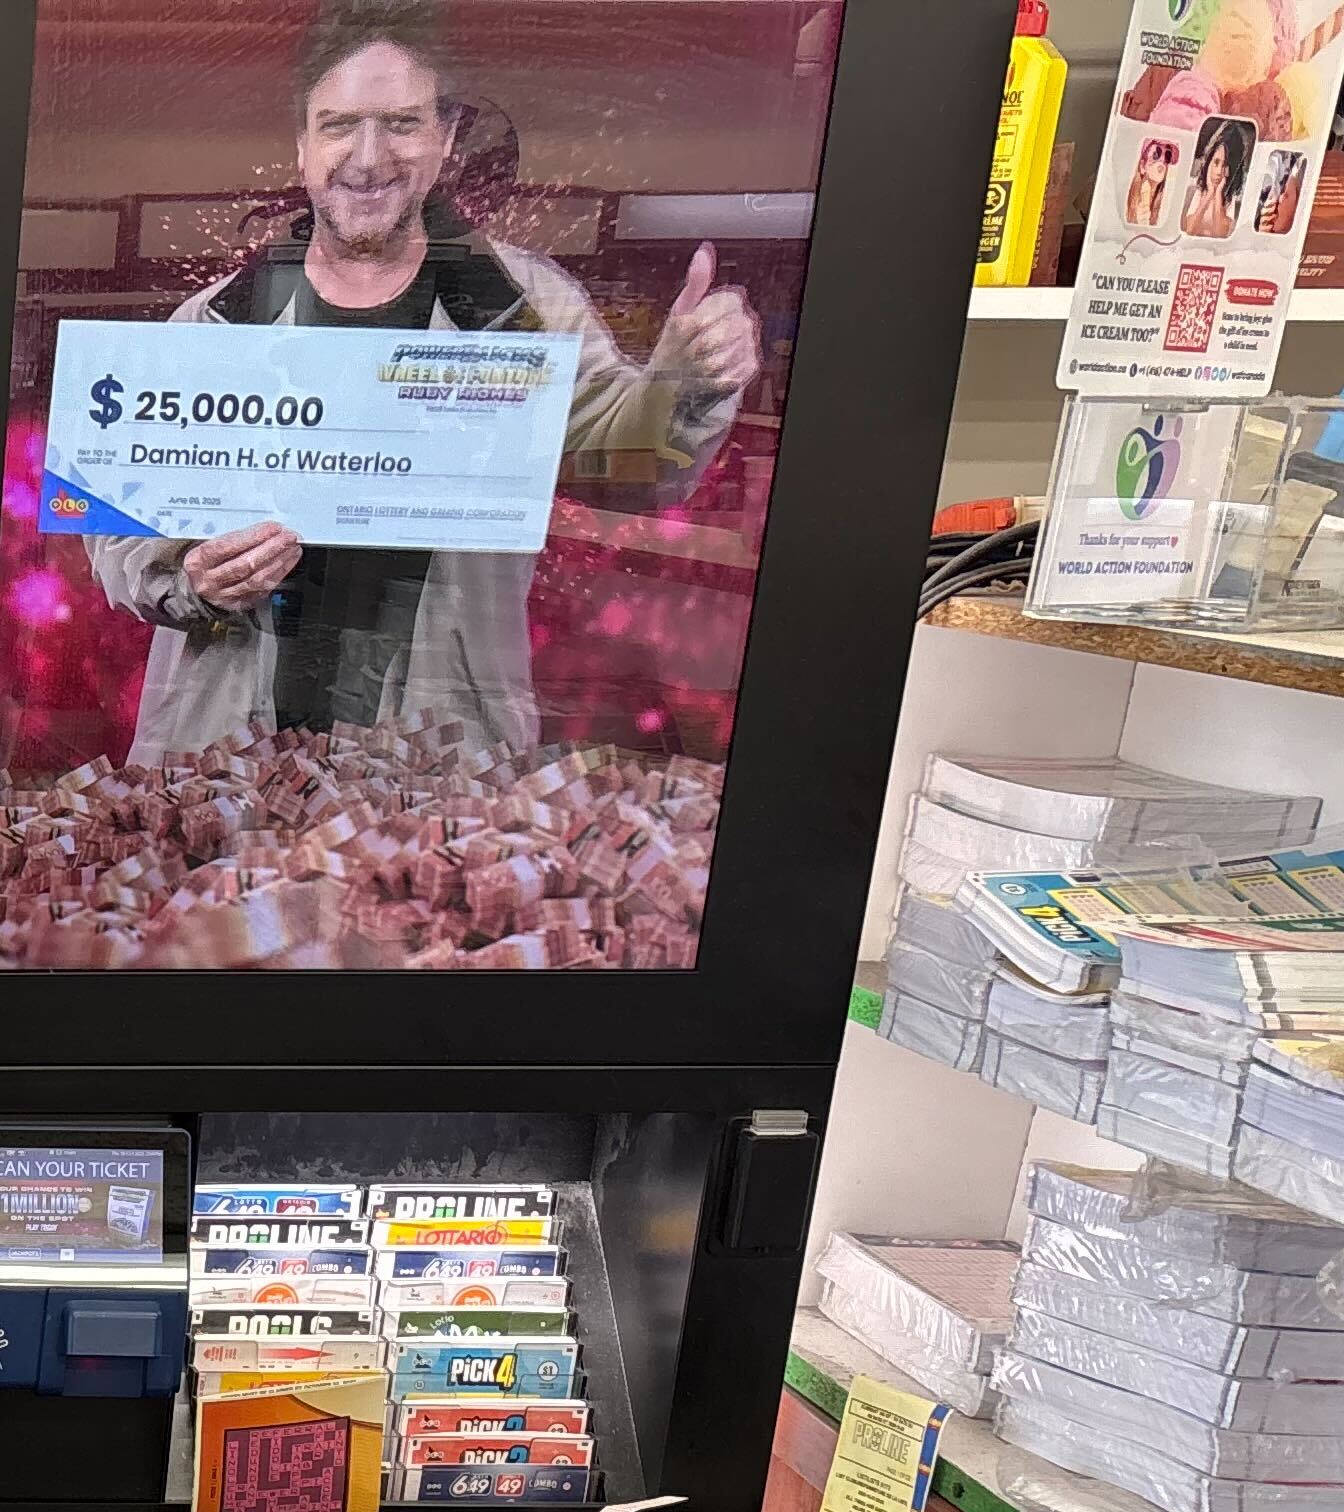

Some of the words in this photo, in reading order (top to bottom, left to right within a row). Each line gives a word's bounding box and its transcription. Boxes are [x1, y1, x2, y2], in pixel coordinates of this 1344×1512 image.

[1141, 31, 1168, 50] WORLD
[1168, 38, 1200, 52] ACTION
[1141, 52, 1193, 69] FOUNDATION
[1093, 273, 1115, 289] "CAN
[1117, 277, 1136, 291] YOU
[1136, 279, 1170, 294] PLEASE
[1234, 286, 1257, 298] DONATE
[1259, 288, 1274, 299] NOW
[1088, 300, 1112, 315] HELP
[1113, 302, 1128, 315] ME
[1130, 303, 1148, 317] GET
[1147, 304, 1162, 318] AN
[1081, 324, 1096, 338] ICE
[1097, 326, 1130, 340] CREAM
[1130, 327, 1160, 342] TOO?"
[89, 373, 124, 429] $
[134, 391, 323, 429] 25,000.00
[398, 386, 453, 399] RUBY
[130, 444, 230, 468] Damian
[237, 448, 258, 469] H.
[265, 448, 291, 470] of
[297, 450, 412, 473] Waterloo
[1080, 534, 1108, 546] Thanks
[1110, 535, 1119, 546] for
[1121, 537, 1139, 548] your
[1141, 536, 1170, 548] support
[1058, 561, 1092, 574] WORLD
[1095, 561, 1132, 574] ACTION
[1134, 561, 1193, 574] FOUNDATION
[33, 1161, 85, 1177] YOUR
[89, 1162, 150, 1178] TICKET
[416, 1230, 502, 1245] LOTTARIO
[853, 1420, 911, 1464] PROLINE
[498, 1479, 522, 1494] 49
